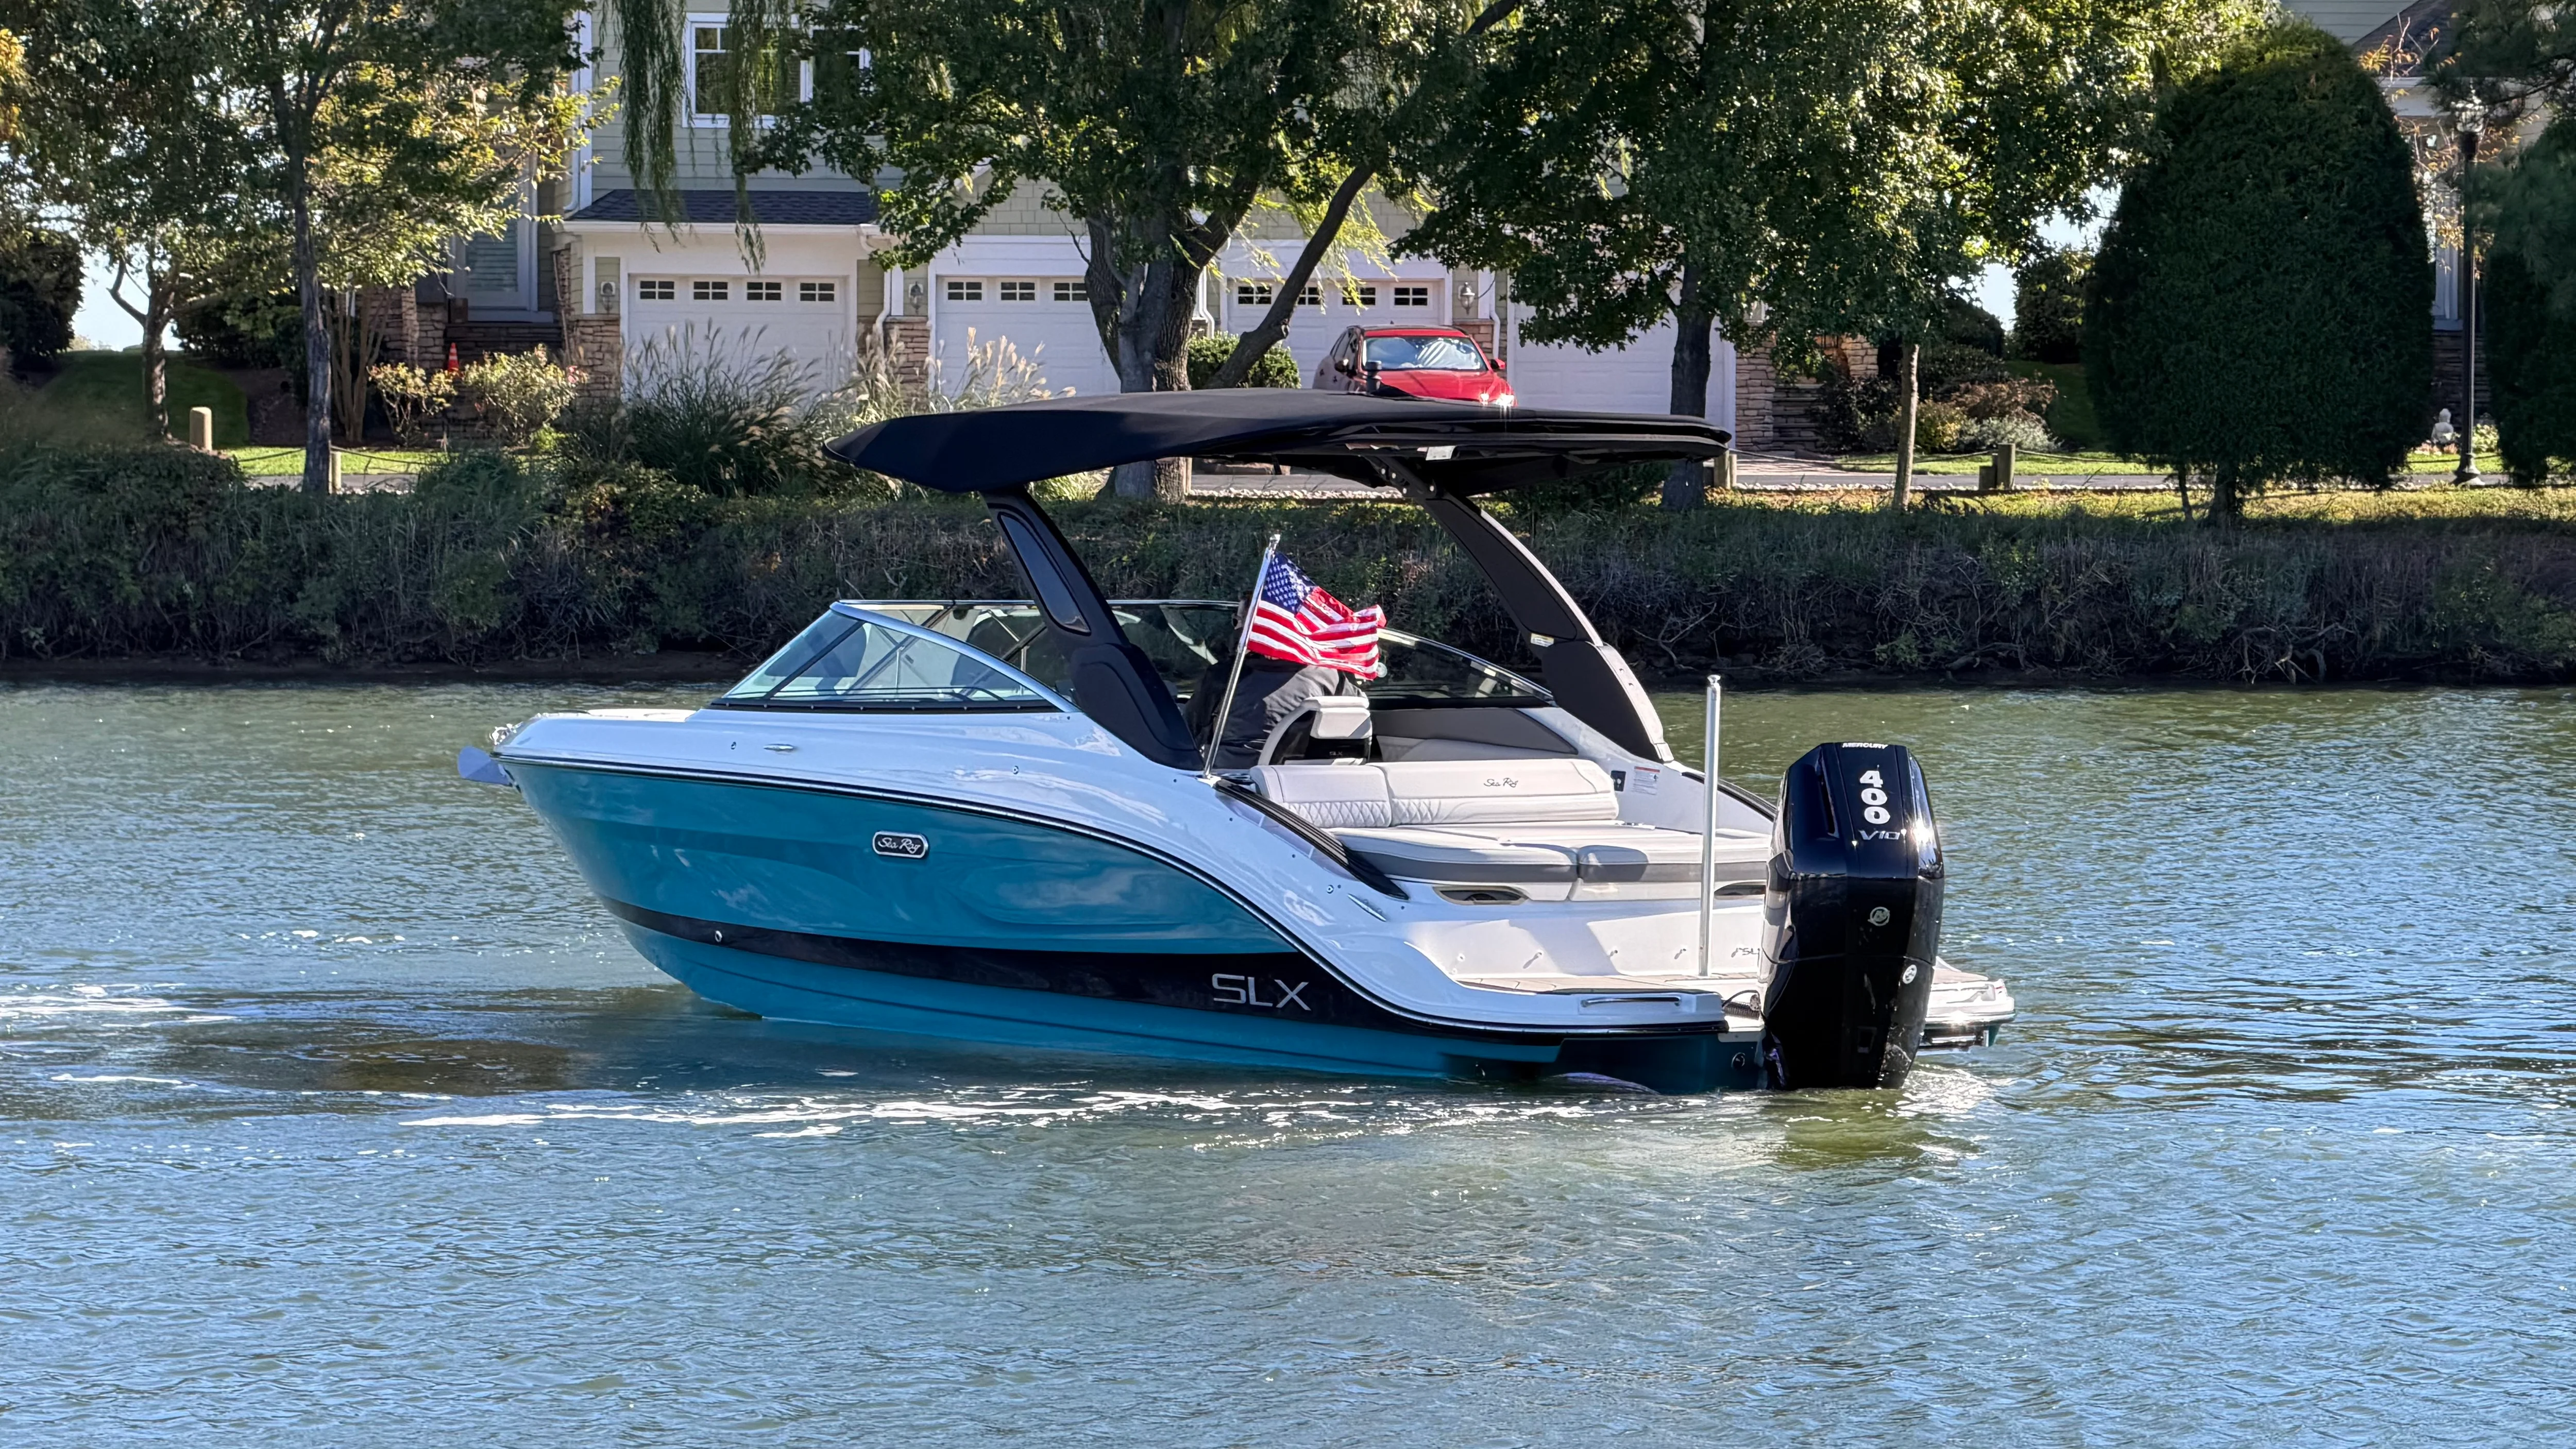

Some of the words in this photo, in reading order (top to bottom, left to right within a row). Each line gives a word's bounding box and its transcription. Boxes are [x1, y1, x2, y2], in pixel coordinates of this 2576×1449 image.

[1483, 778, 1501, 787] Sea
[1503, 777, 1519, 788] Ray
[1859, 770, 1891, 825] 400
[1858, 829, 1901, 840] V10
[877, 837, 899, 848] Sea
[899, 838, 921, 854] Ray
[1212, 973, 1312, 1011] SLX
